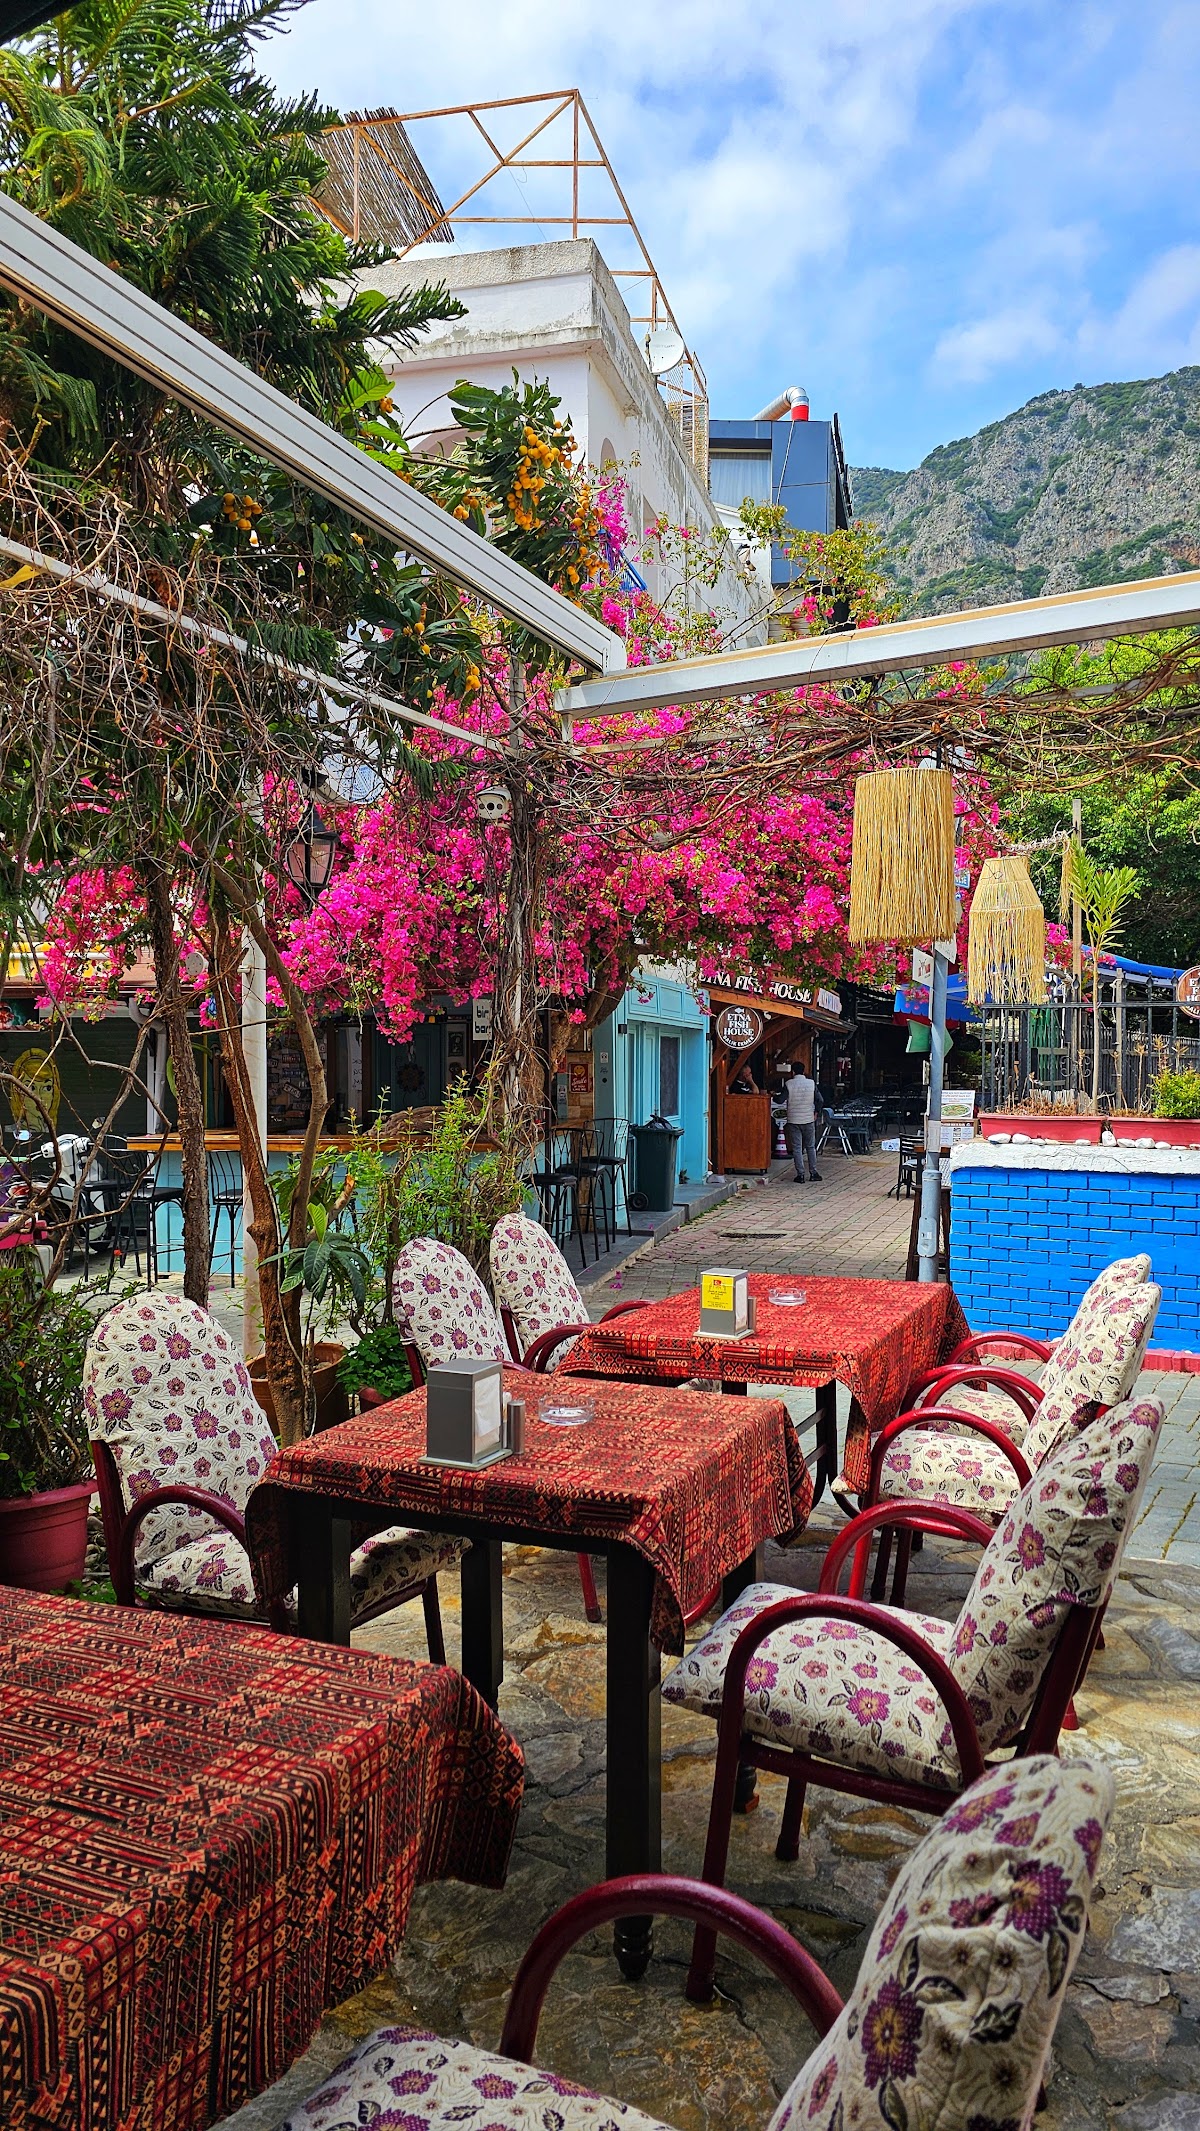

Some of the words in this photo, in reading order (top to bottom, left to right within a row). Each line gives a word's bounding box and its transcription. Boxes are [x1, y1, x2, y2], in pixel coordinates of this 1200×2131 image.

[769, 982, 812, 1003] HOUSE
[729, 1021, 749, 1029] FISH
[723, 1028, 754, 1036] HOUSE
